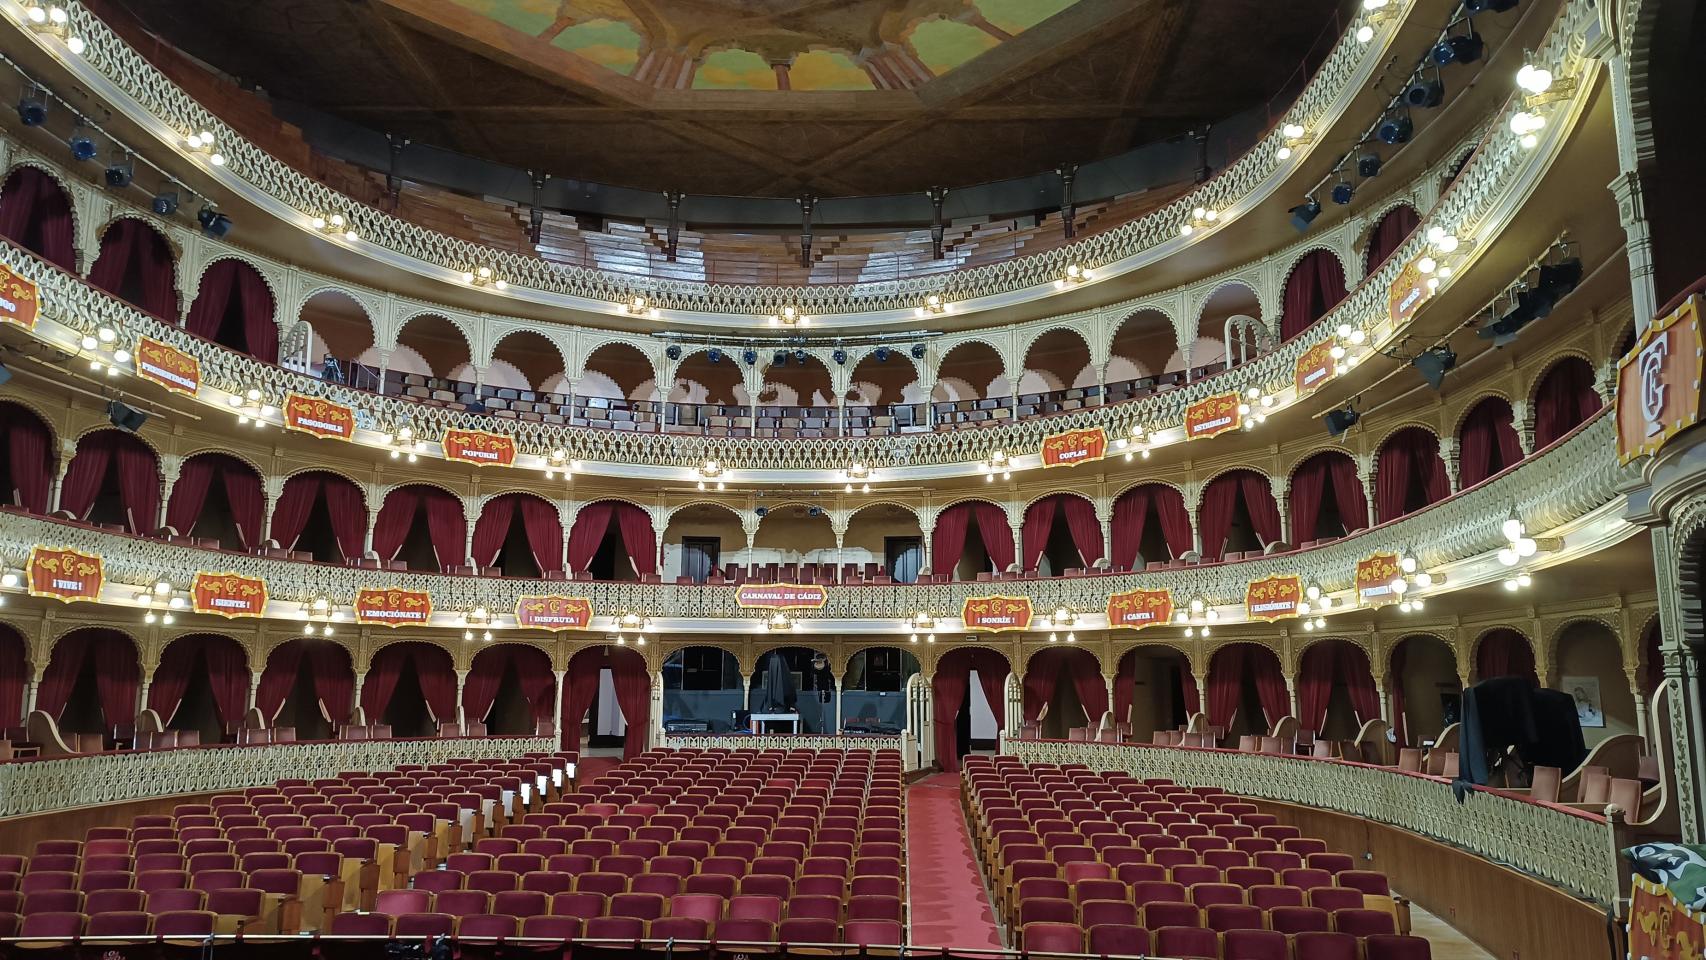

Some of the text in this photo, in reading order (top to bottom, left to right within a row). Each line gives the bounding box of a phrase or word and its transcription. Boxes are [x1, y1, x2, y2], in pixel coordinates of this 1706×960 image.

[297, 416, 343, 433] PASODOBLE
[462, 449, 498, 460] POPURRÍ
[1059, 449, 1088, 460] COPLAS
[741, 592, 783, 600] CARNAVAL
[797, 591, 822, 600] CÁDIZ
